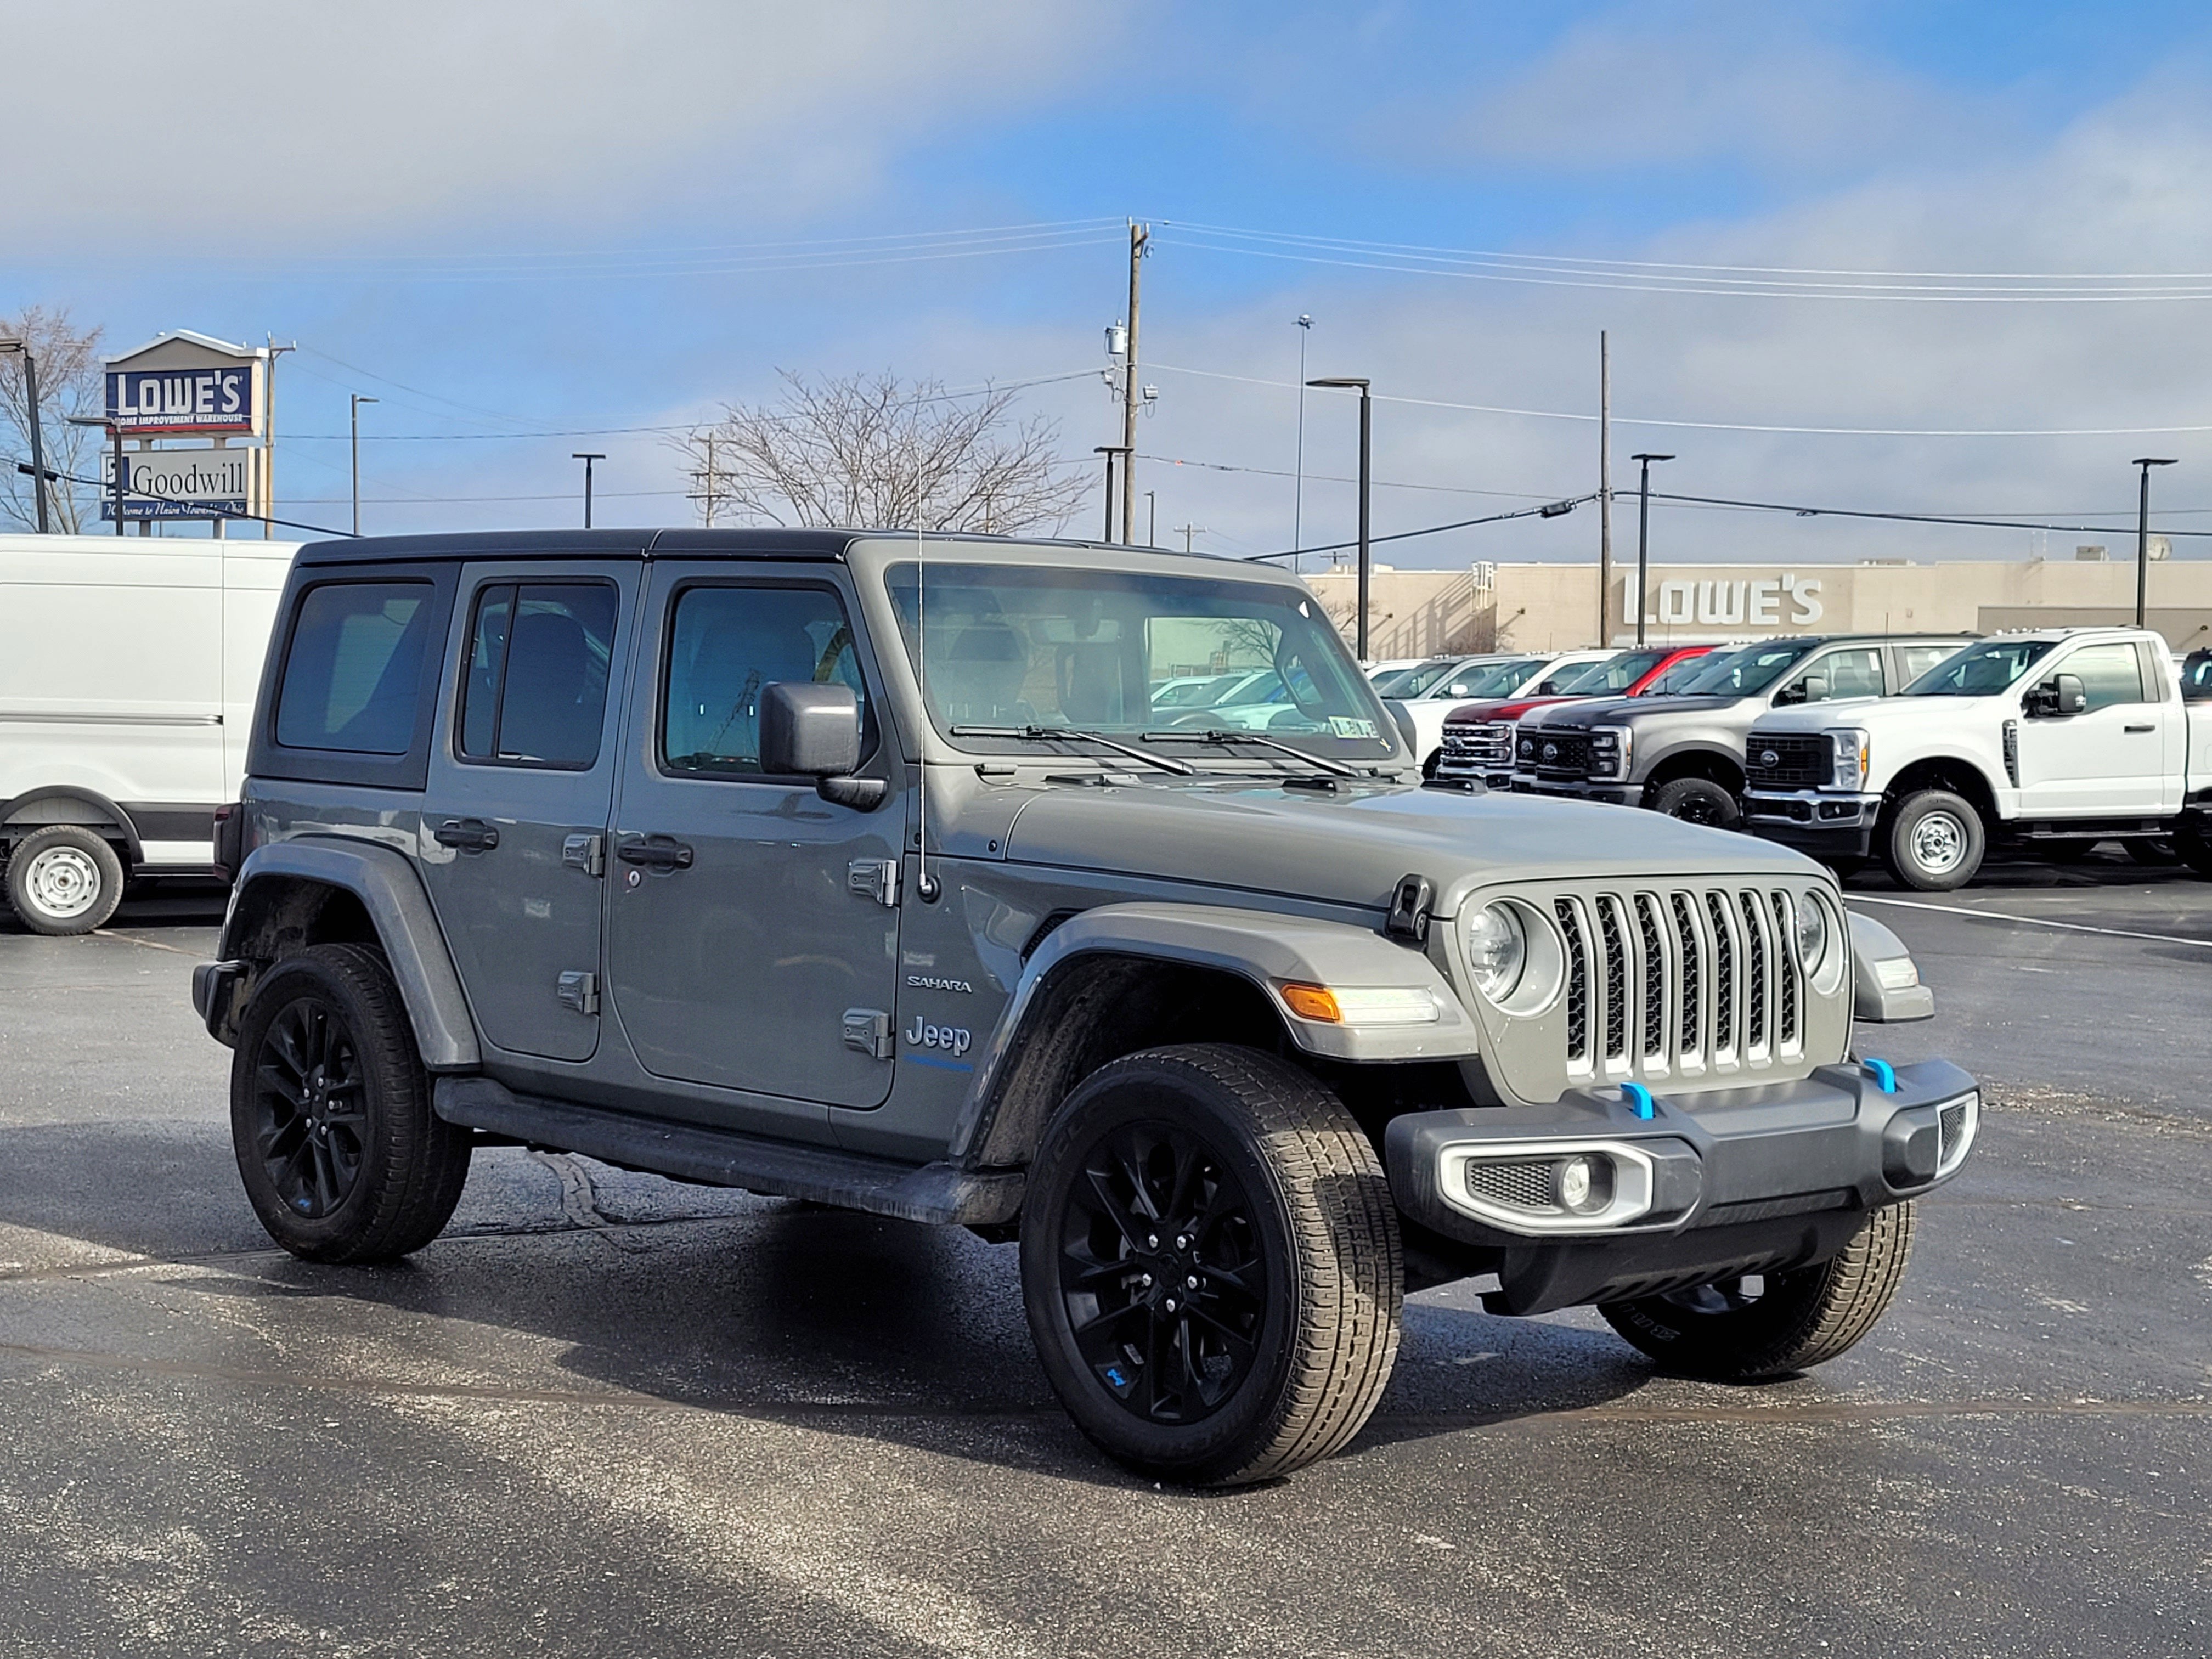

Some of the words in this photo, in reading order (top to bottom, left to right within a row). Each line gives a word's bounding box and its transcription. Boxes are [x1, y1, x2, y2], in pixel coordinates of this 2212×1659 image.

[118, 370, 240, 415] LOWE'S
[139, 415, 194, 425] IMPROVEMENT
[196, 414, 243, 424] WAREHOUSE
[133, 462, 243, 494] Goodwill
[107, 503, 143, 515] Wlcome
[145, 505, 153, 515] to
[155, 501, 180, 515] Union
[182, 501, 221, 517] Townshp
[1624, 573, 1822, 625] LOWE'S
[907, 975, 973, 994] SAHARA
[905, 1015, 970, 1057] Jeep
